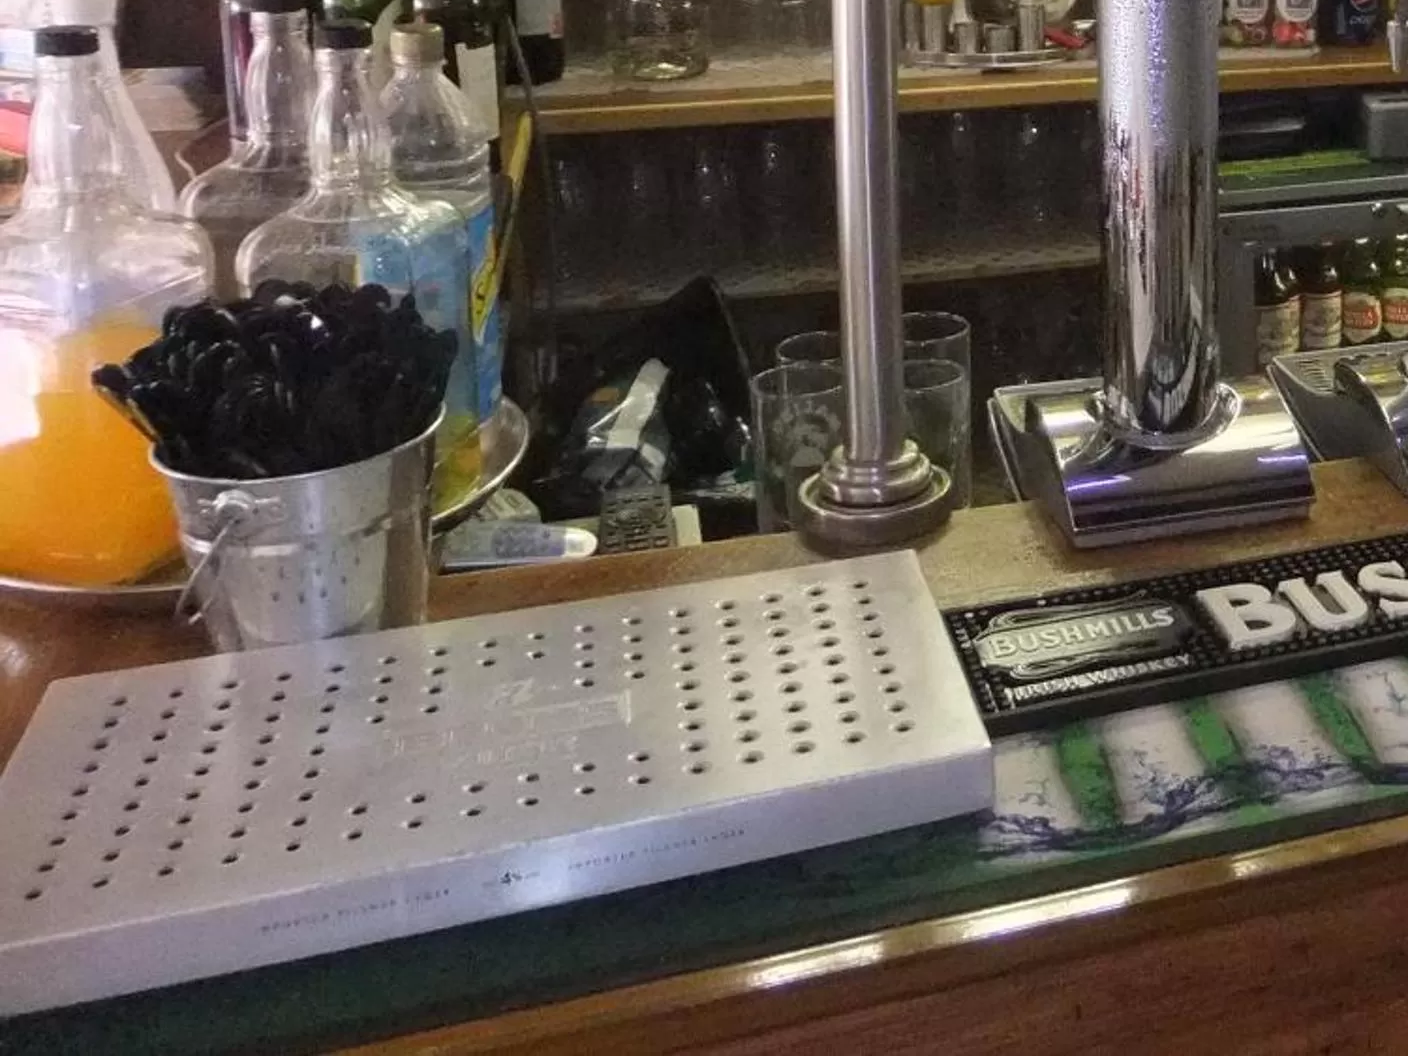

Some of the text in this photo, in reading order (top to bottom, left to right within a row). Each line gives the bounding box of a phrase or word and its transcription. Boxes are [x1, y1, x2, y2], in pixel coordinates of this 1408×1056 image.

[989, 606, 1175, 658] BUSHMILLS
[1014, 652, 1190, 701] IRISH WHISKEY
